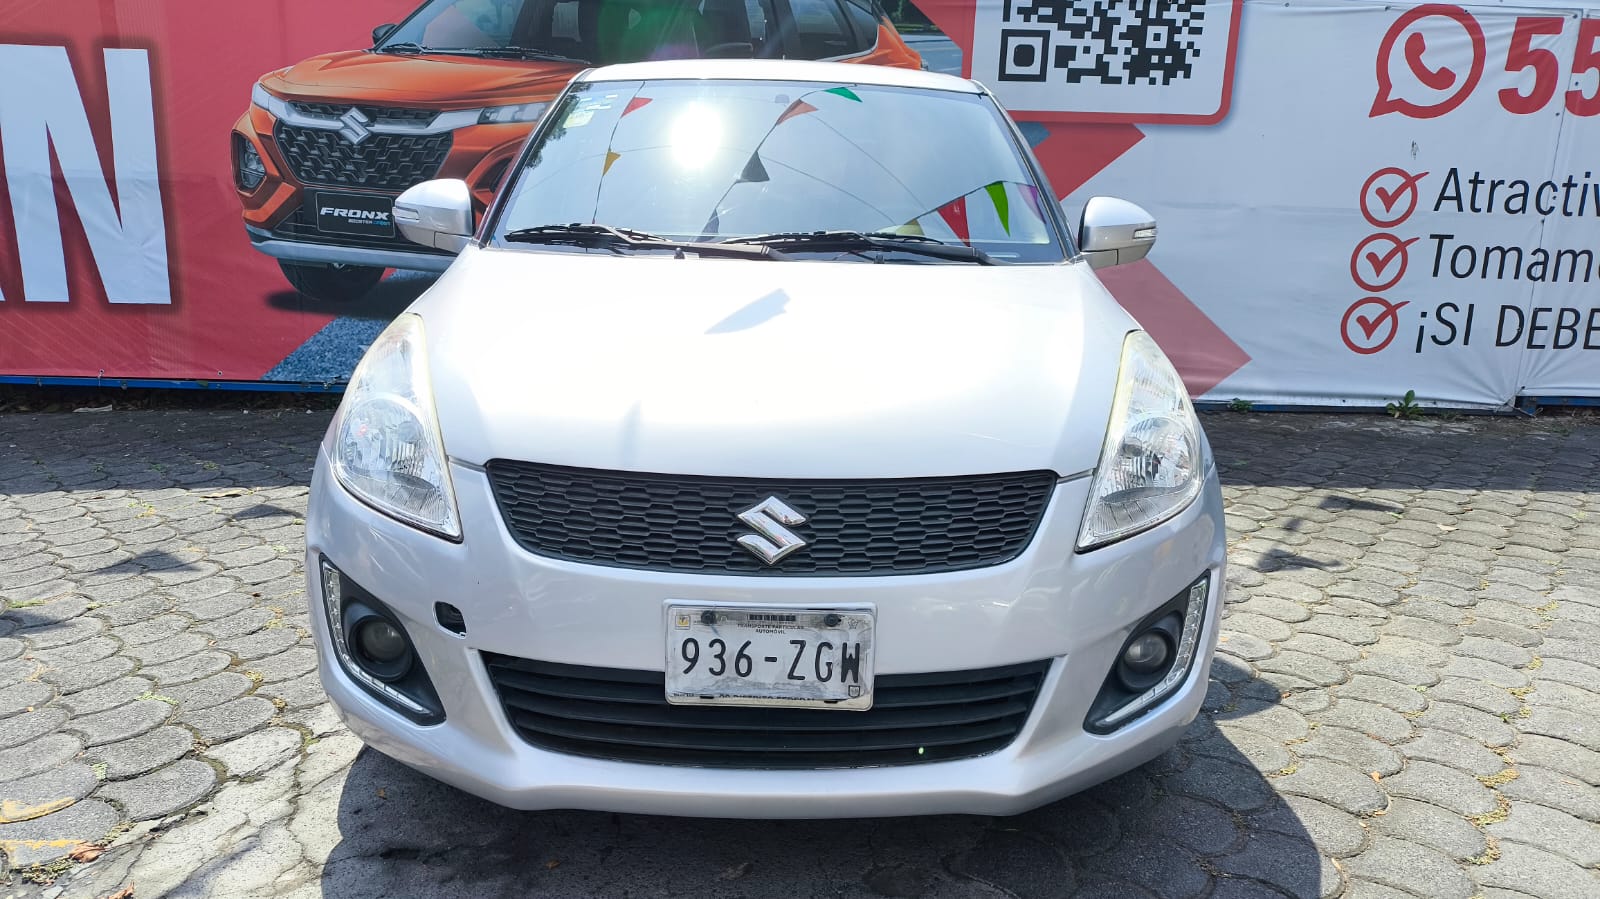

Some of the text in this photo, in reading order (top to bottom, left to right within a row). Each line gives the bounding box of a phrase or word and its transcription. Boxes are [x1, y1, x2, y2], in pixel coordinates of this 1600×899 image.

[320, 207, 389, 220] FRONX
[1429, 234, 1600, 283] Tomam
[1415, 302, 1475, 353] ¡SI
[681, 637, 861, 683] 936-ZGW
